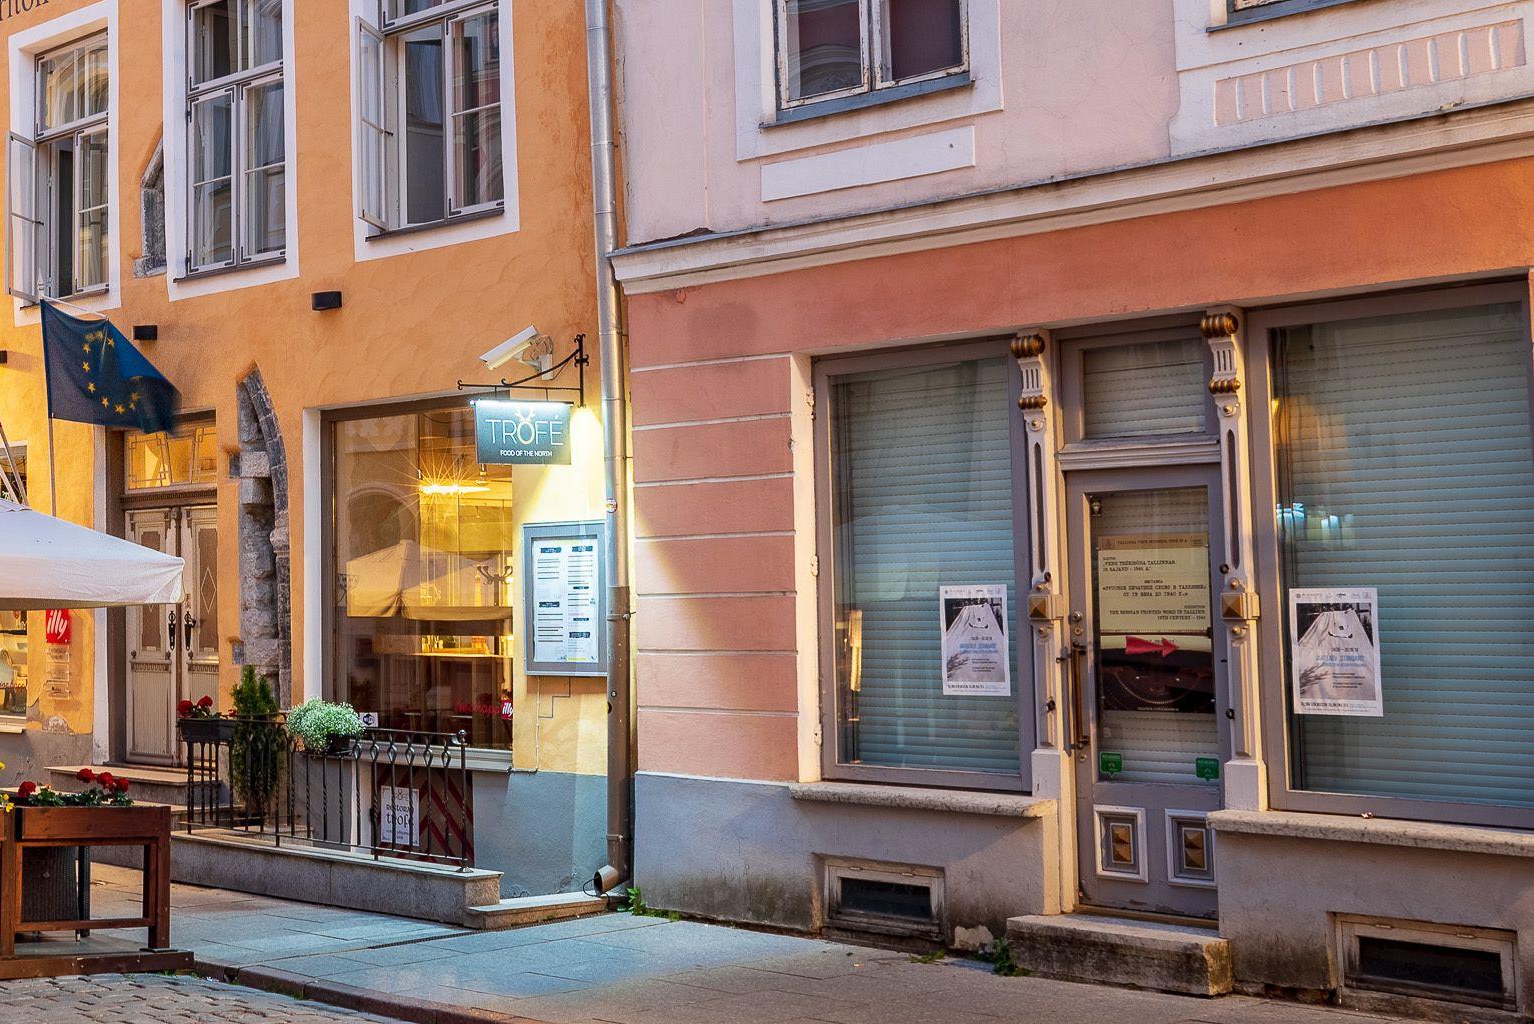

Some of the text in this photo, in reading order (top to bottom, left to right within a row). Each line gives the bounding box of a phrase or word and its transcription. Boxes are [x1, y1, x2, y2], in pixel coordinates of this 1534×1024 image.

[500, 449, 516, 457] FOOD
[47, 610, 68, 640] illy
[502, 701, 514, 718] illy
